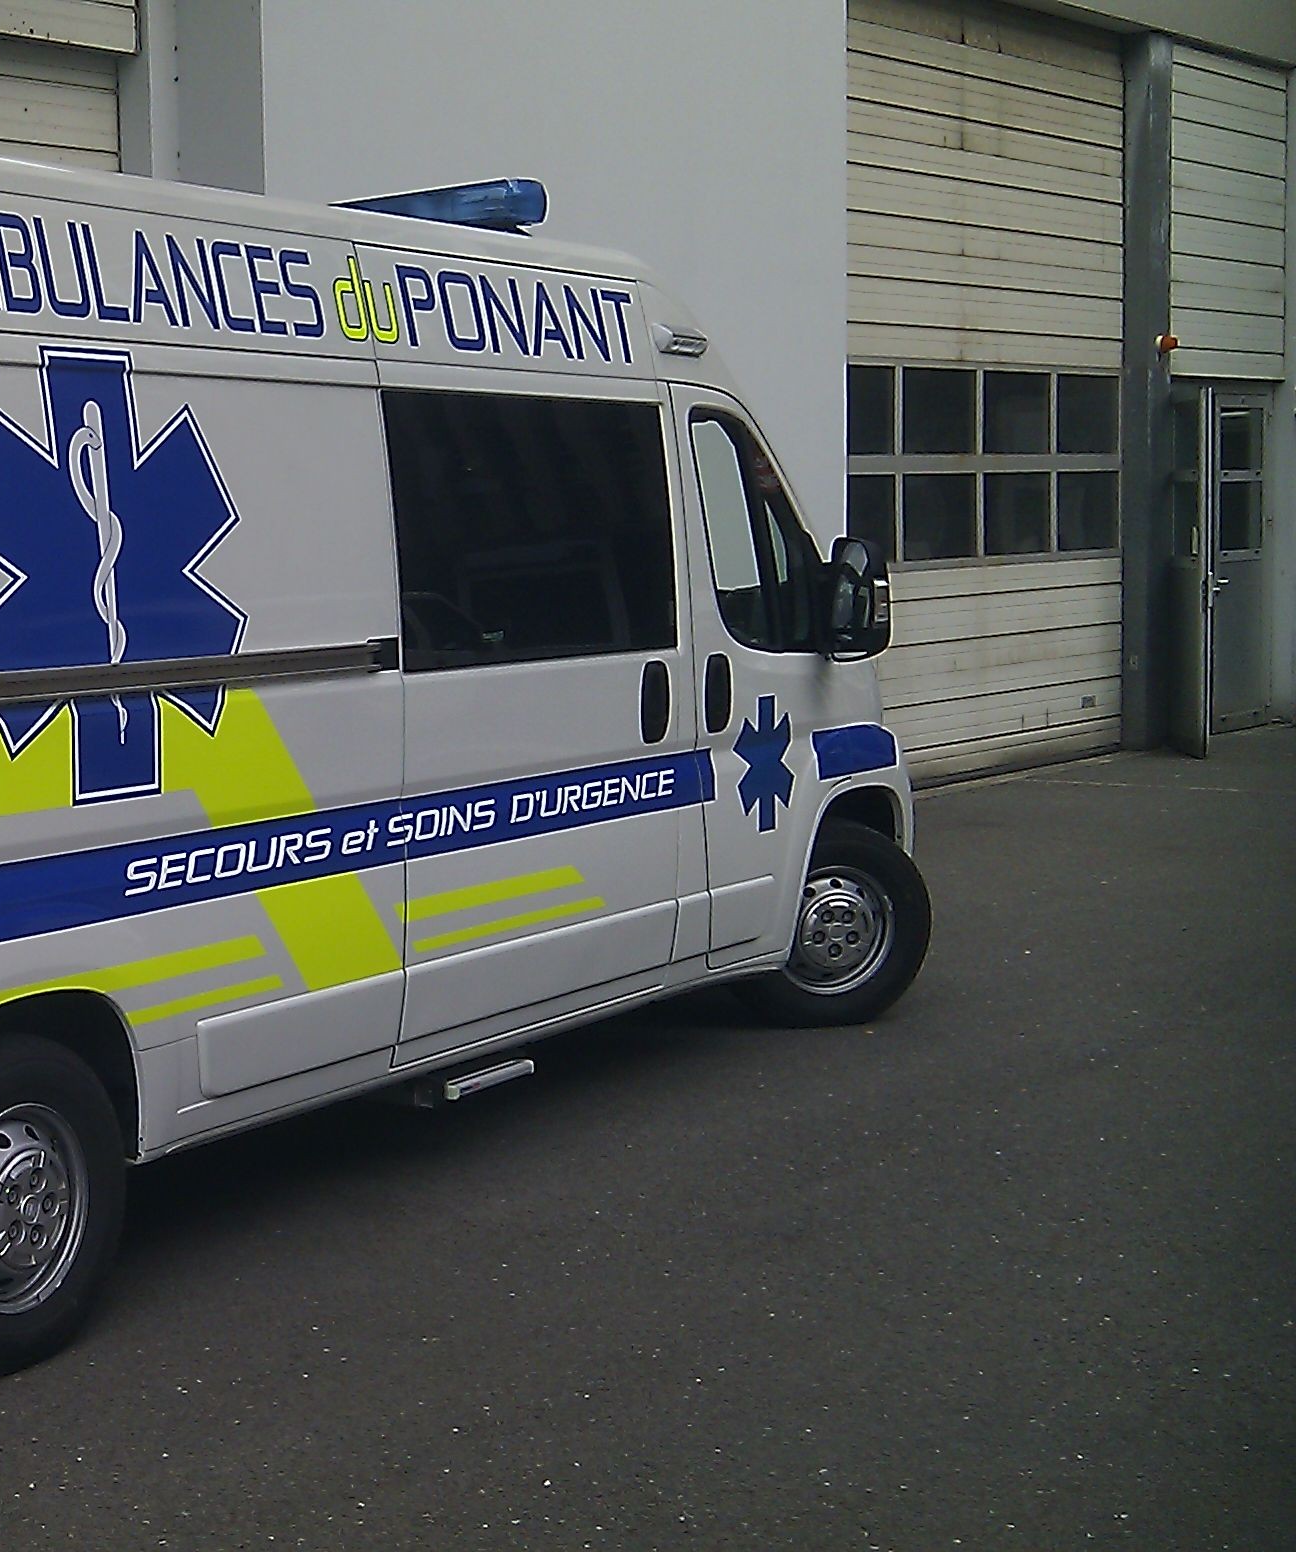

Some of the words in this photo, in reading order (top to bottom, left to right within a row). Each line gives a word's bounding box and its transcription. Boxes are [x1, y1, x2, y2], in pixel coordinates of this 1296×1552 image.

[333, 255, 399, 344] du
[394, 263, 632, 364] PONANT
[124, 827, 332, 896] SECOURS
[341, 819, 379, 855] et
[386, 799, 496, 847] SOINS
[510, 769, 675, 823] D'URGENCE
